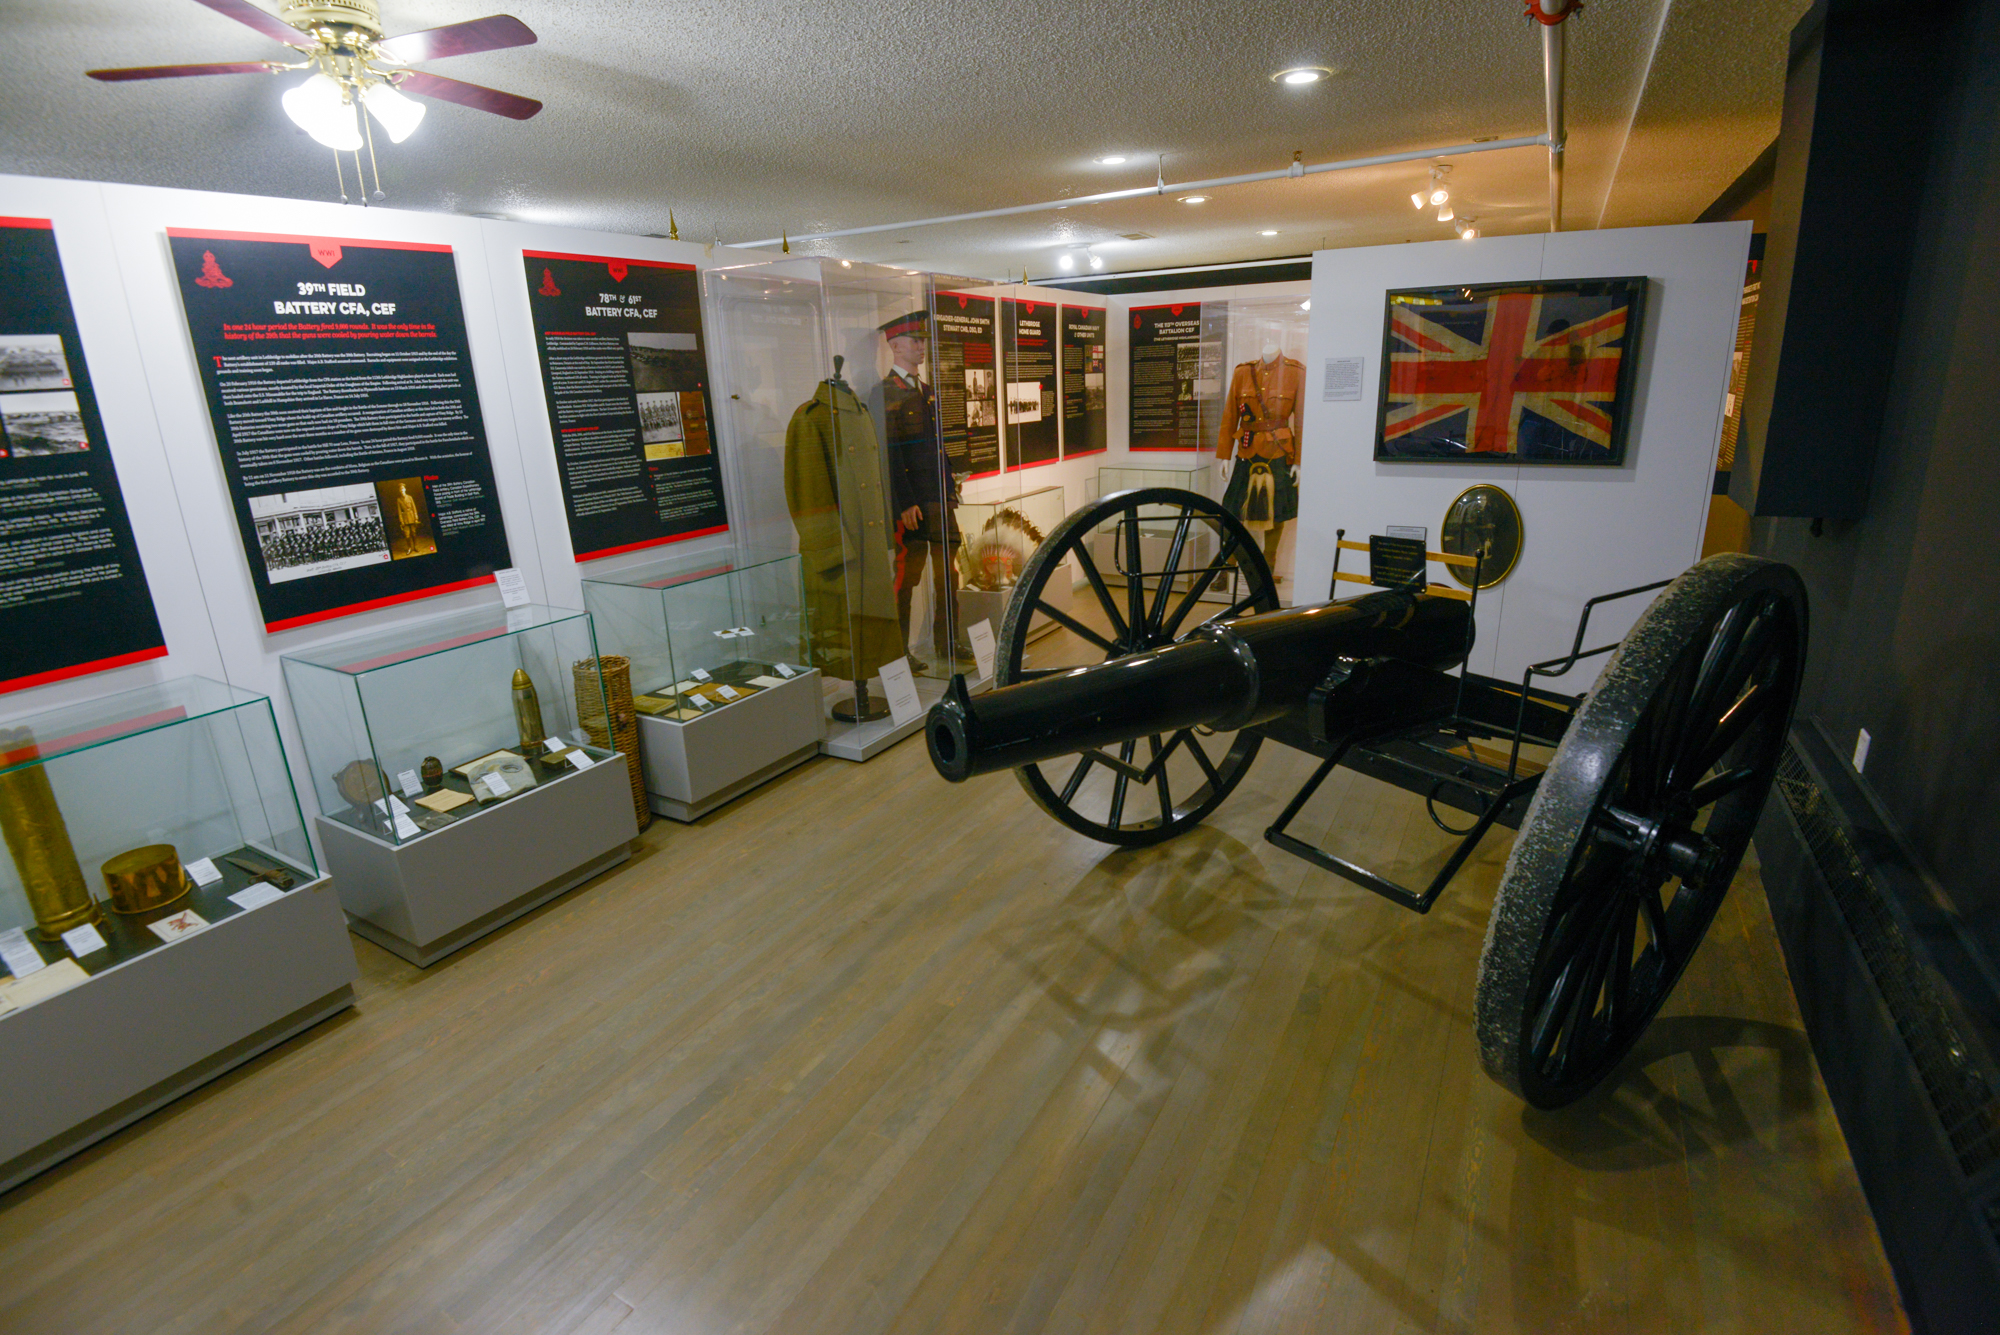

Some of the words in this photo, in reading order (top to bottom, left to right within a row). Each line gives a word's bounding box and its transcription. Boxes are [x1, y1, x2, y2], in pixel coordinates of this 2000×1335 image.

[317, 249, 335, 257] WWI
[297, 282, 326, 296] 39TH
[328, 284, 366, 297] FIELD
[599, 293, 617, 304] 78TH
[619, 294, 625, 303] &
[628, 294, 642, 305] 61ST
[274, 301, 336, 315] BATTERY
[339, 302, 370, 317] CFA,
[371, 303, 396, 316] CEF
[585, 306, 622, 317] BATTERY
[623, 307, 642, 319] CFA,
[643, 308, 658, 318] CEF
[252, 323, 267, 331] hour
[267, 323, 287, 332] period
[288, 323, 298, 331] the
[298, 322, 320, 332] Battery
[320, 322, 334, 332] fired
[397, 323, 409, 332] only
[409, 322, 421, 330] time
[427, 322, 435, 330] the
[1019, 320, 1041, 328] LETHBRIDGE
[358, 331, 379, 340] pouring
